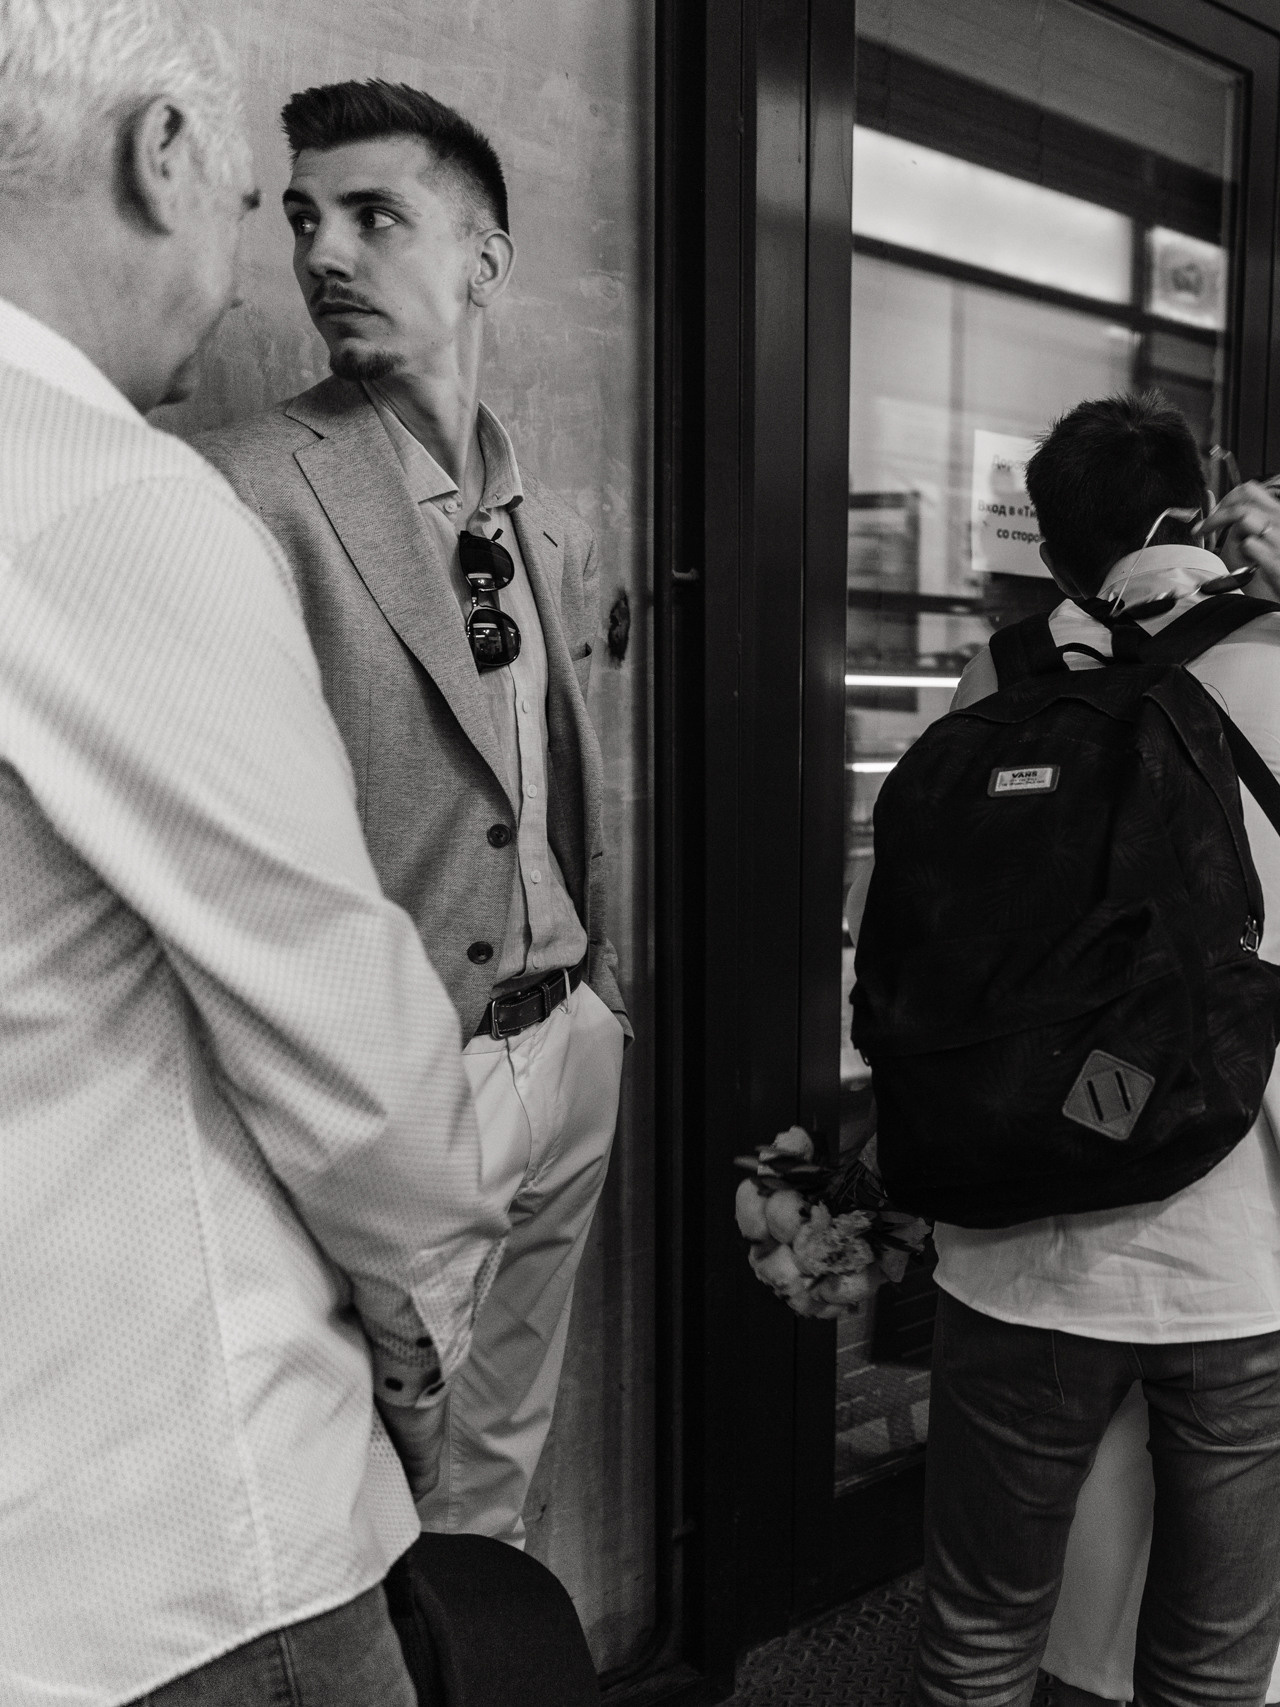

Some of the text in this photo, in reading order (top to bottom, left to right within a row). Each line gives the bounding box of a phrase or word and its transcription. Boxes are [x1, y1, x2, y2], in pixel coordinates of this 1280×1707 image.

[1017, 505, 1038, 518] «Ти
[996, 528, 1045, 544] со сторо
